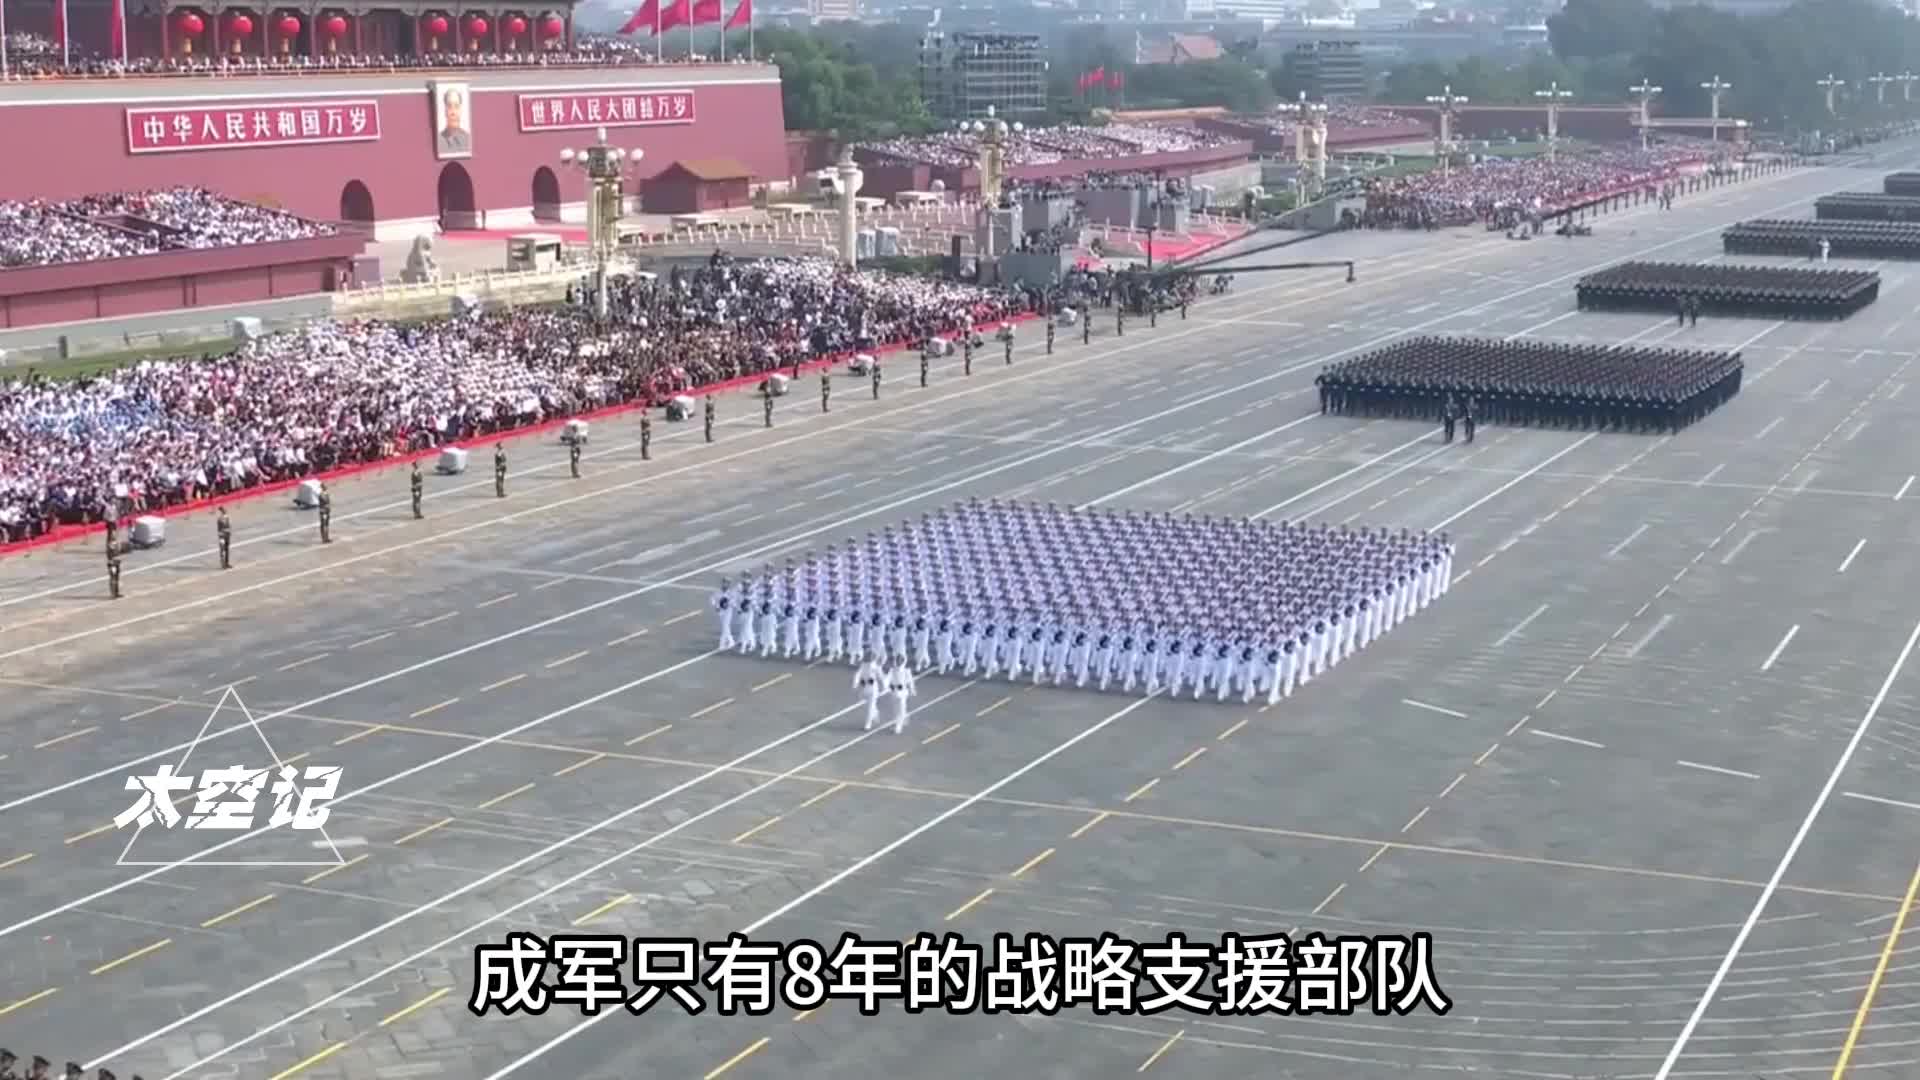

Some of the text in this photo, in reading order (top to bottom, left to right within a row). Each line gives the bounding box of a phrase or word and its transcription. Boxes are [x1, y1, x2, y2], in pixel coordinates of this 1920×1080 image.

[143, 107, 366, 144] 中华人民共和国万岁
[532, 96, 686, 124] 世界人民大团结万岁
